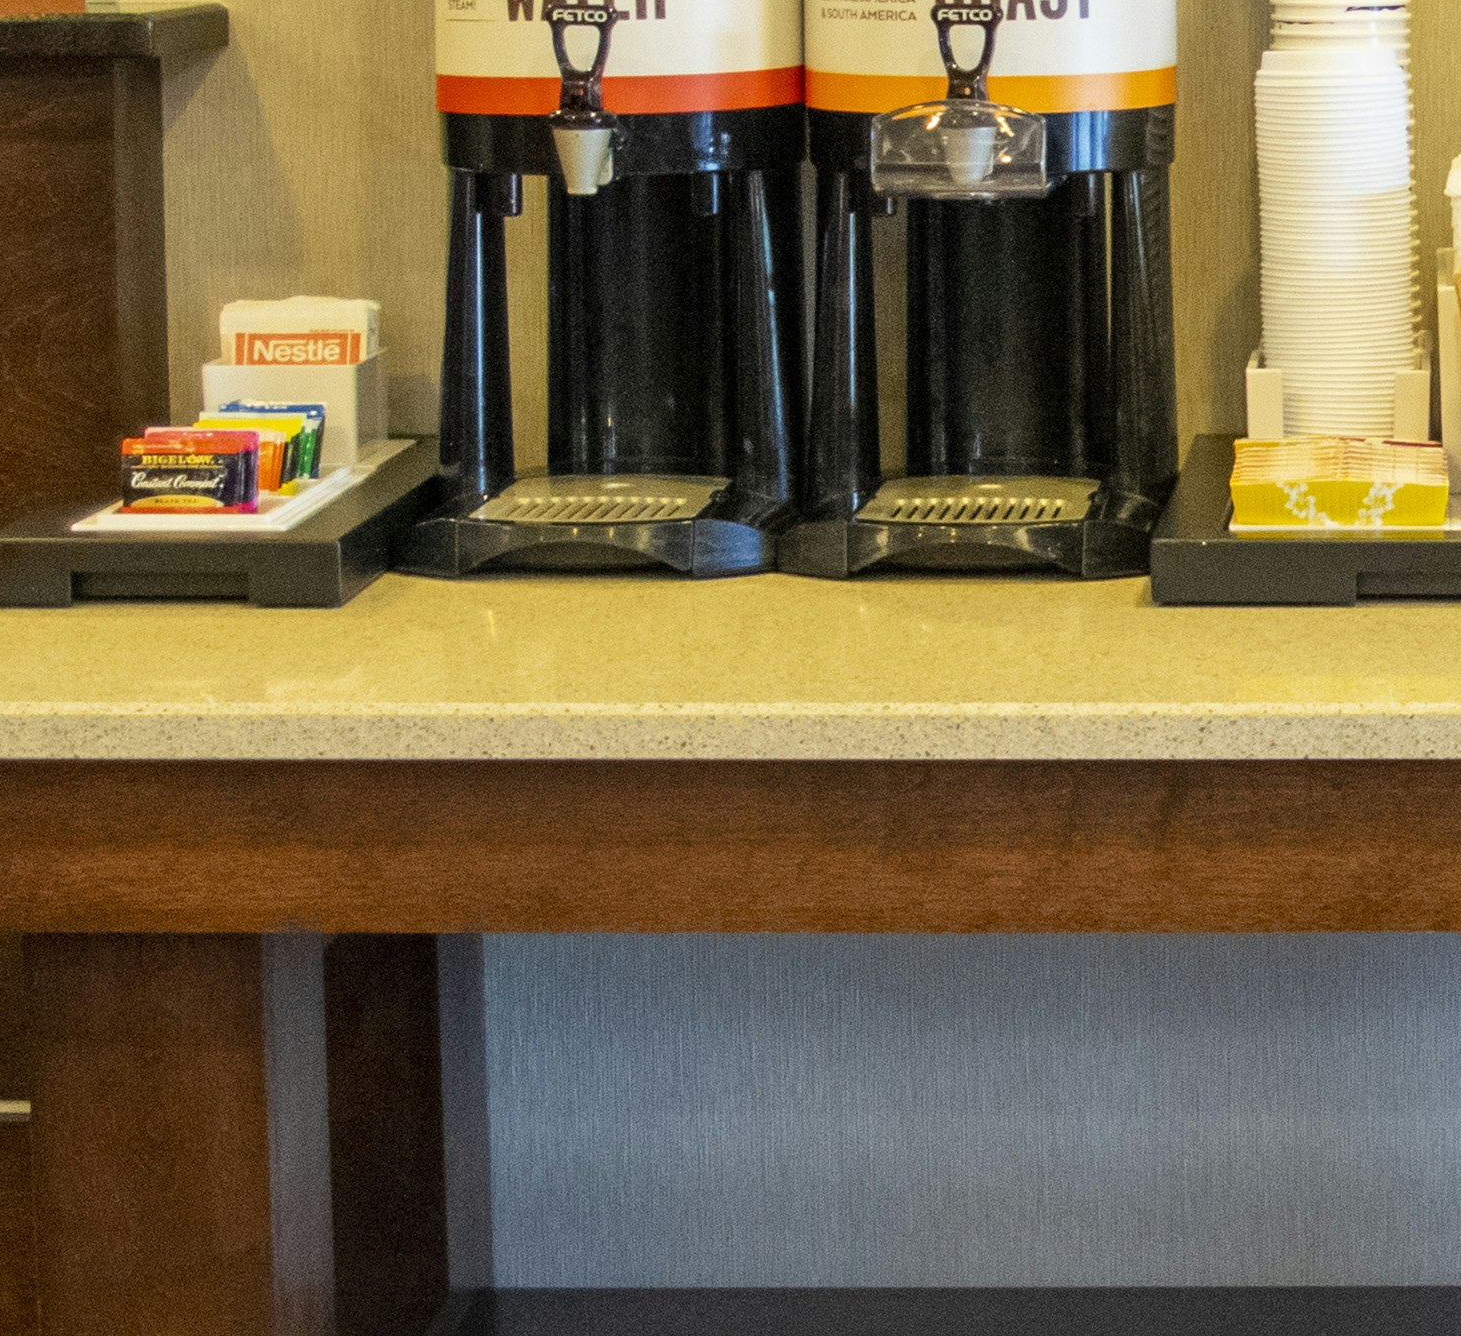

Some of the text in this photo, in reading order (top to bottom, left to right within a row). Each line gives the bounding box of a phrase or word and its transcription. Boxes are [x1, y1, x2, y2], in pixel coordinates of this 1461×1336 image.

[552, 10, 608, 23] FETCO
[827, 8, 858, 20] SOUTH
[859, 10, 918, 22] AMERICA
[937, 9, 993, 22] FETCO
[141, 454, 213, 465] BIGELOW
